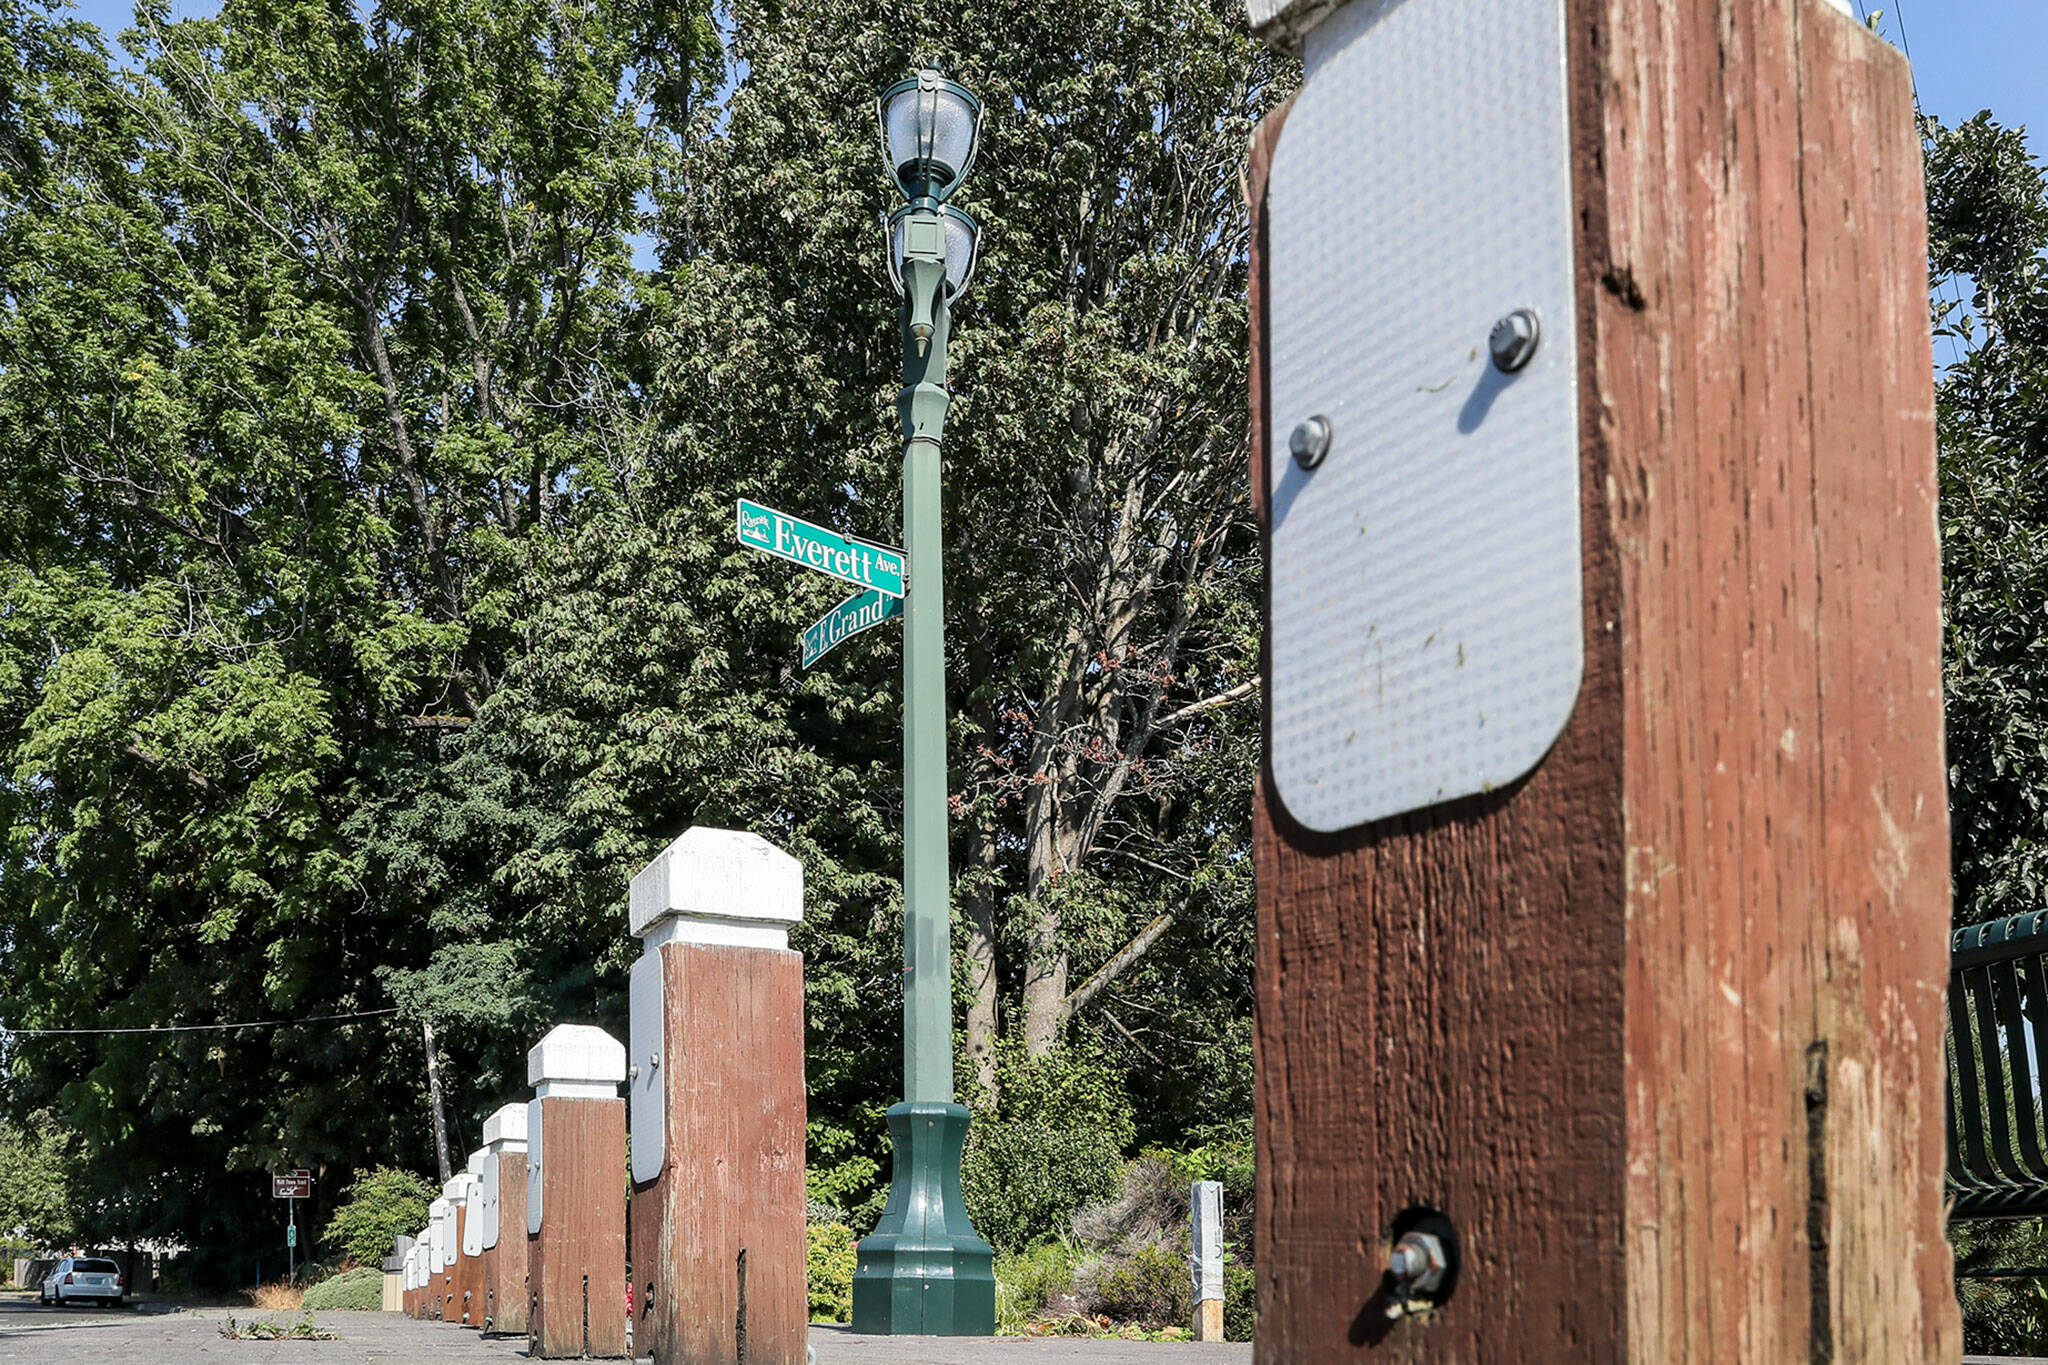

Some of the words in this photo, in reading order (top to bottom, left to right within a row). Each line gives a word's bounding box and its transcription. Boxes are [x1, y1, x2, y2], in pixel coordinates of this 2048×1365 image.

[772, 514, 873, 583] Everett
[874, 553, 900, 576] Ave.
[819, 619, 829, 653] E
[829, 591, 884, 643] Grand
